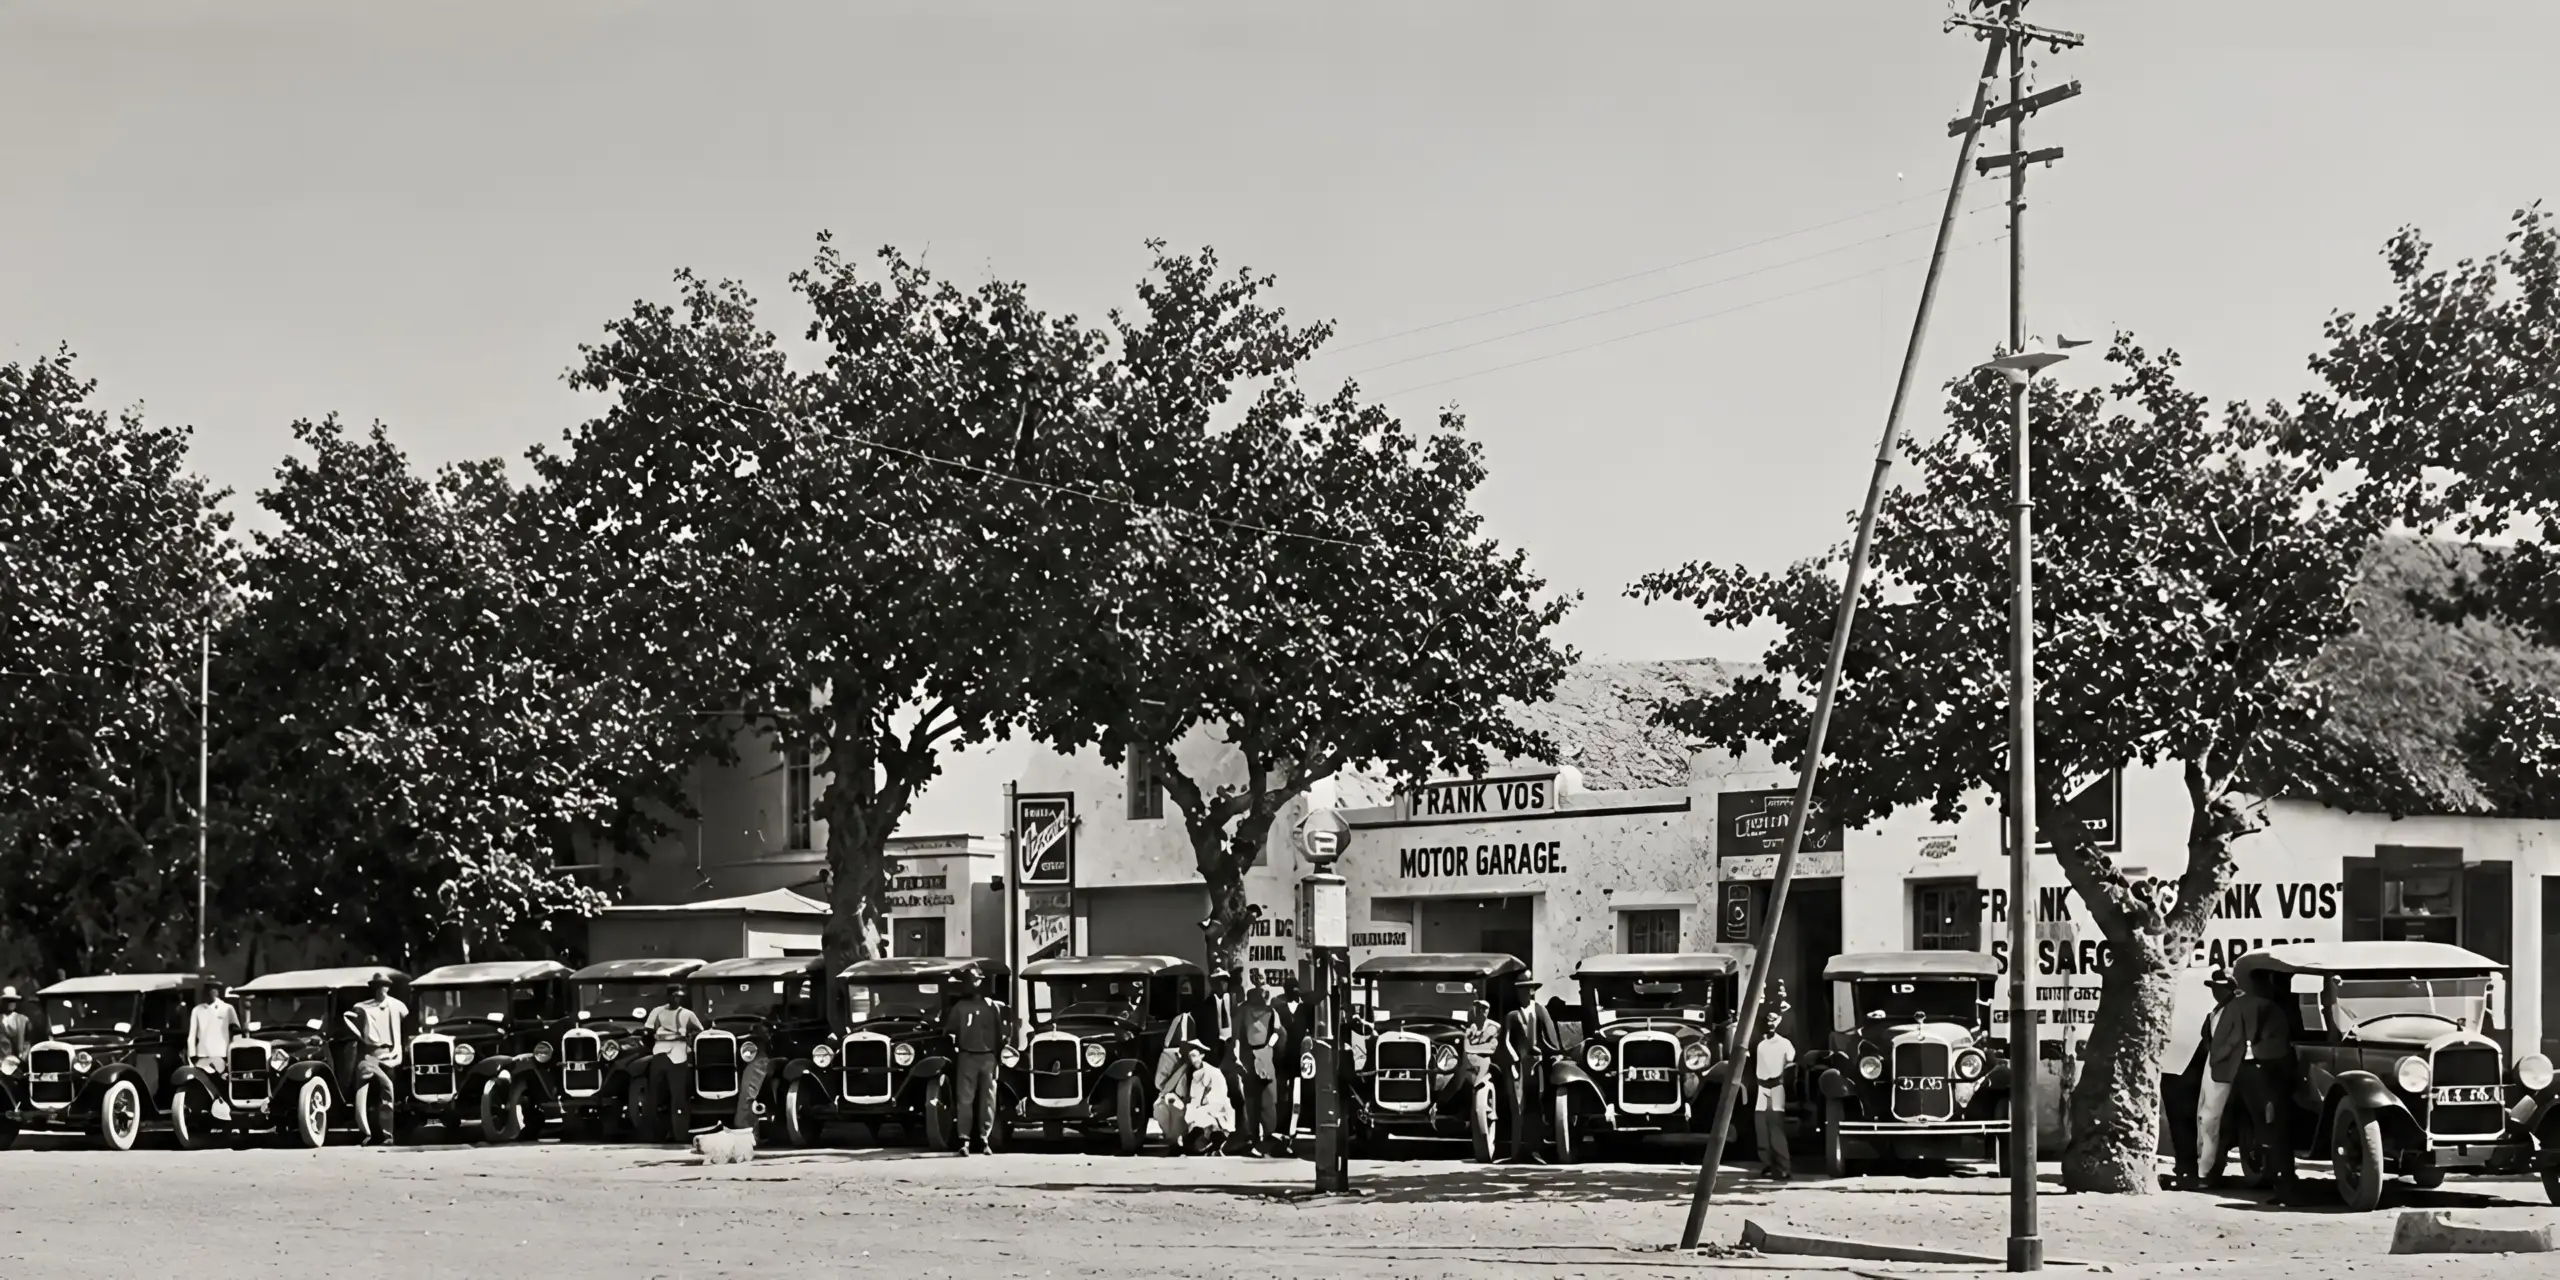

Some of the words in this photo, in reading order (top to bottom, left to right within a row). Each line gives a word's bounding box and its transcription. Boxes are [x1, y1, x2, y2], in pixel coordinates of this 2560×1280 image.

[1412, 784, 1487, 816] FRANK
[1497, 782, 1544, 811] VOS
[1400, 846, 1468, 878] MOTOR
[1476, 841, 1567, 876] GARAGE.
[1979, 886, 2072, 922] FRNK
[2209, 883, 2262, 918] ANK
